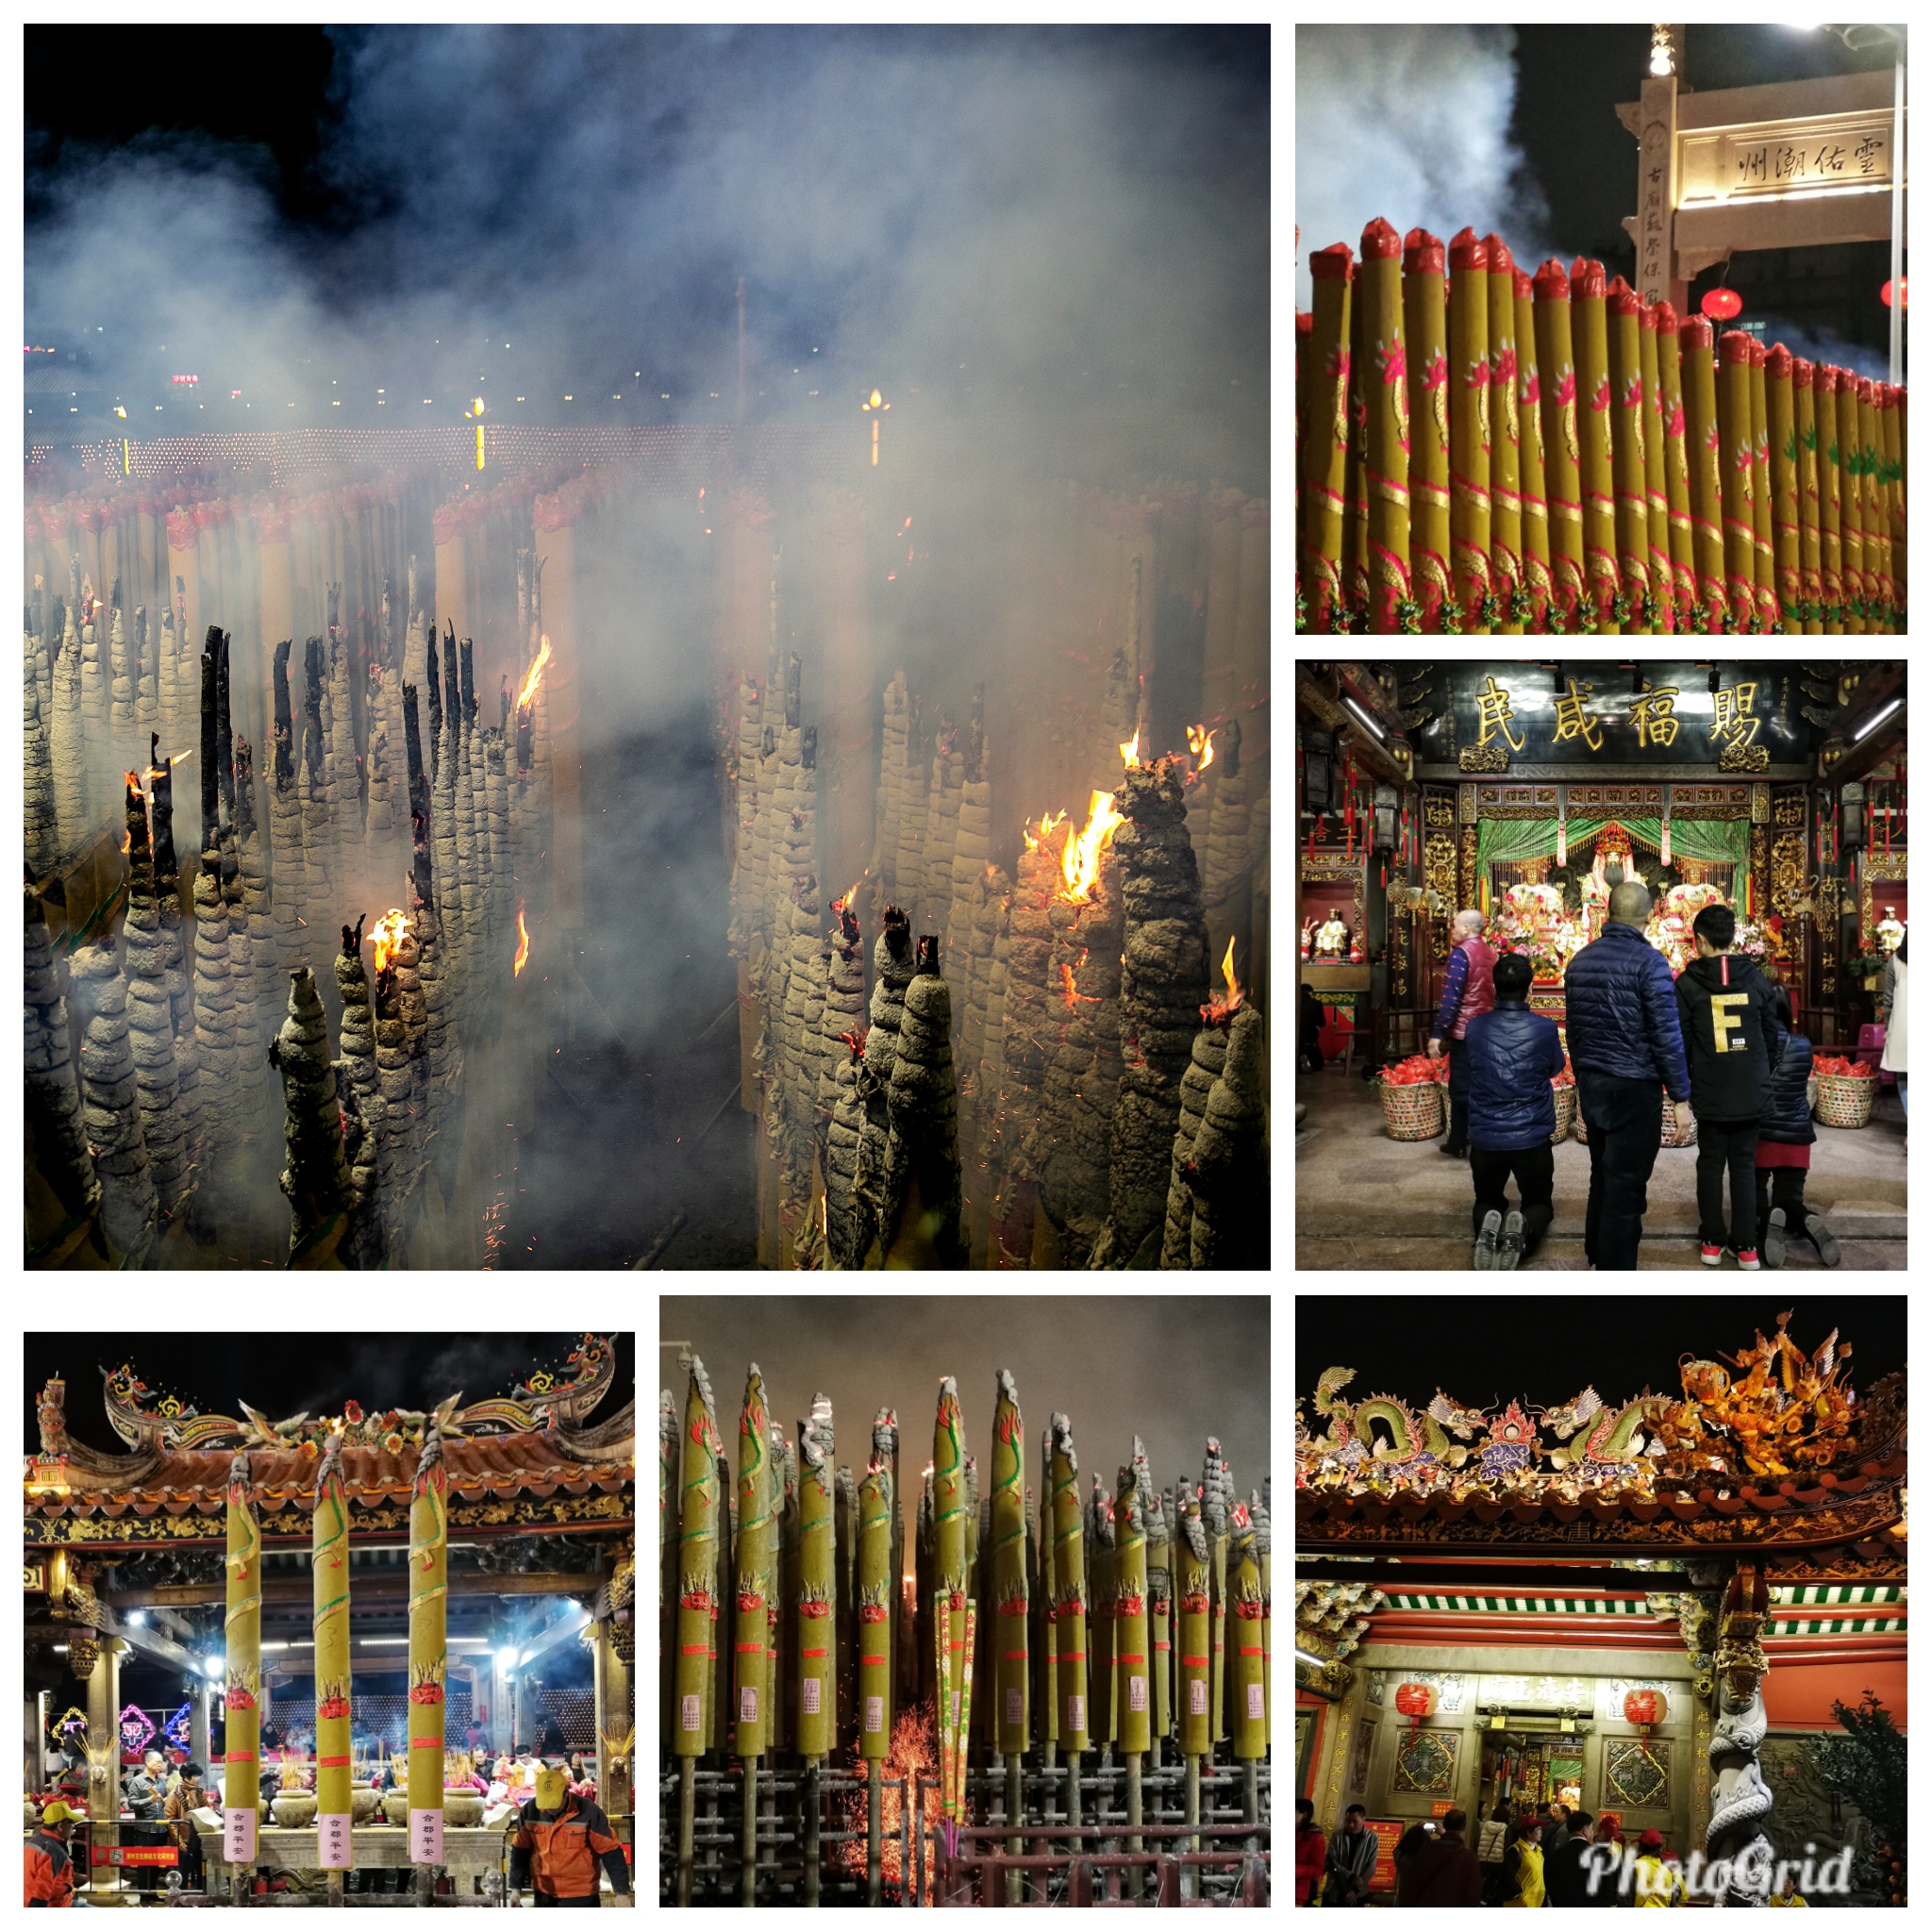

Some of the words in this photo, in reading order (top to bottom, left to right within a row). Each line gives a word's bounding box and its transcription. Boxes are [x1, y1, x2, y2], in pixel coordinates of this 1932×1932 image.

[1710, 992, 1749, 1053] F
[329, 1819, 341, 1861] 合郡平安
[422, 1814, 435, 1857] 合郡平安
